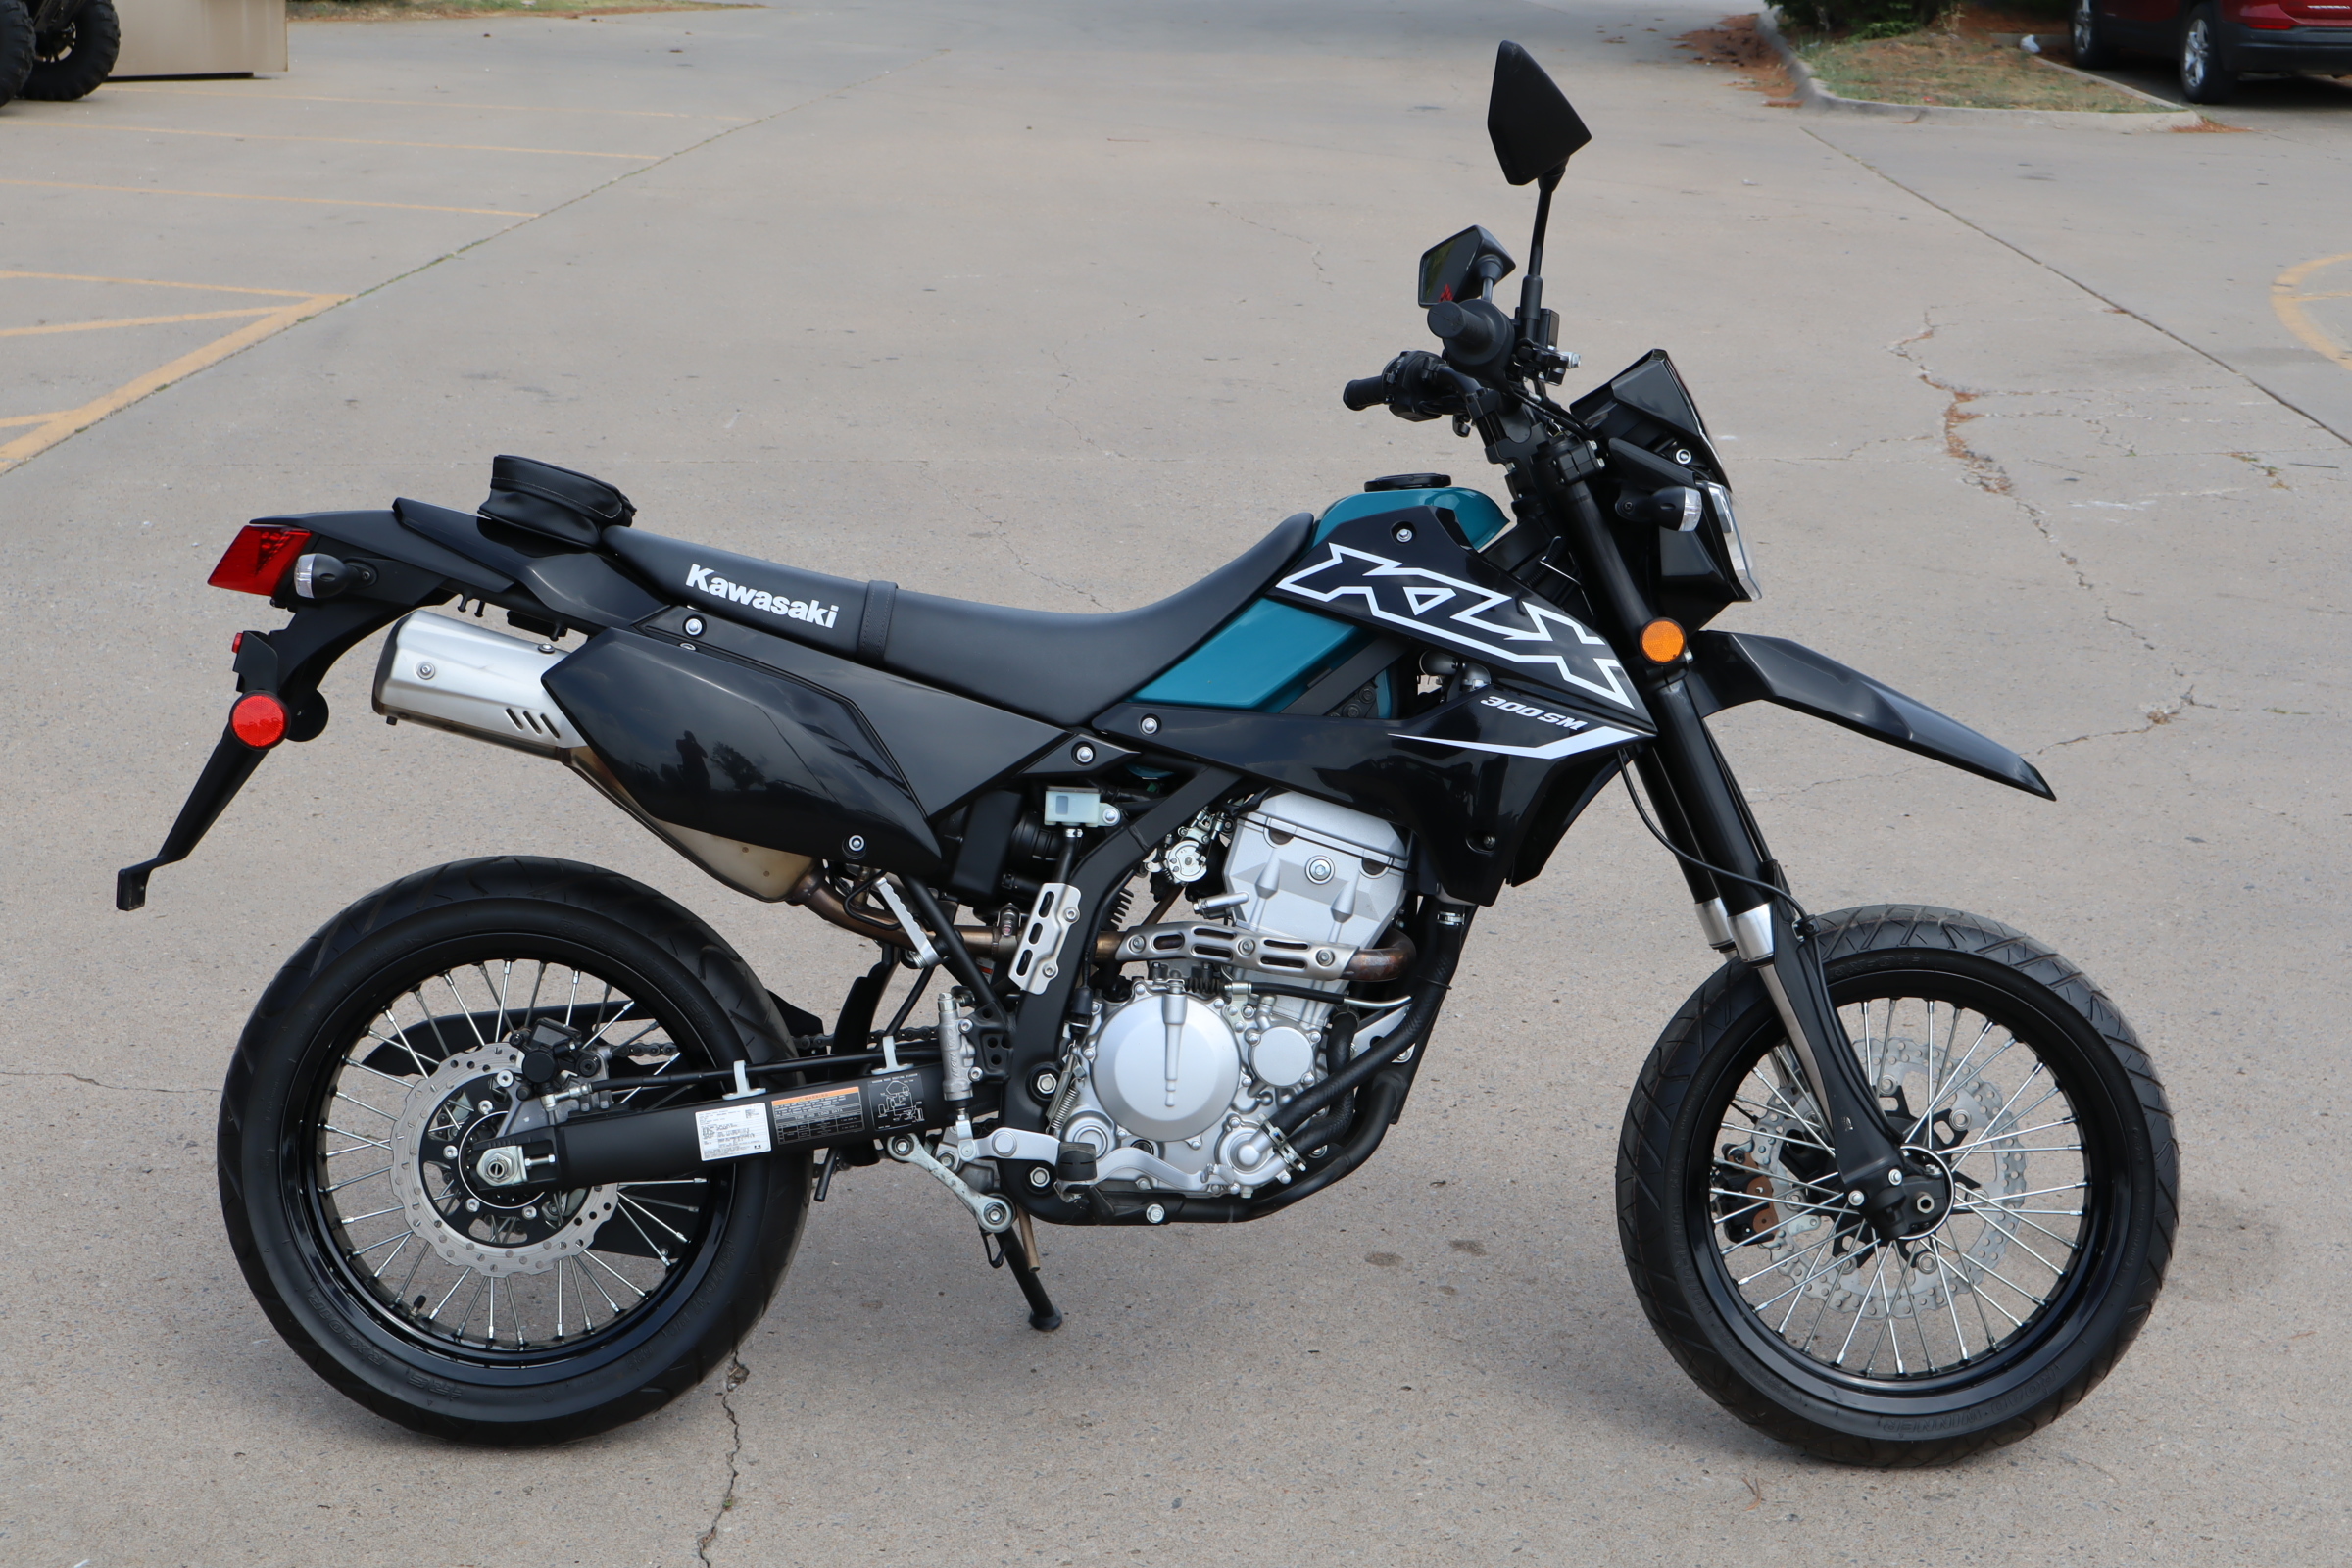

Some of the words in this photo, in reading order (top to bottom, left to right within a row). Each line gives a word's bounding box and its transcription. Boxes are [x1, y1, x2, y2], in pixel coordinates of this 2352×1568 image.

[685, 564, 840, 629] Kawasaki
[1480, 696, 1589, 731] 300SM
[307, 1294, 390, 1366] RX-01R
[1990, 1364, 2057, 1415] ROAD
[1883, 1408, 1983, 1434] WINNER
